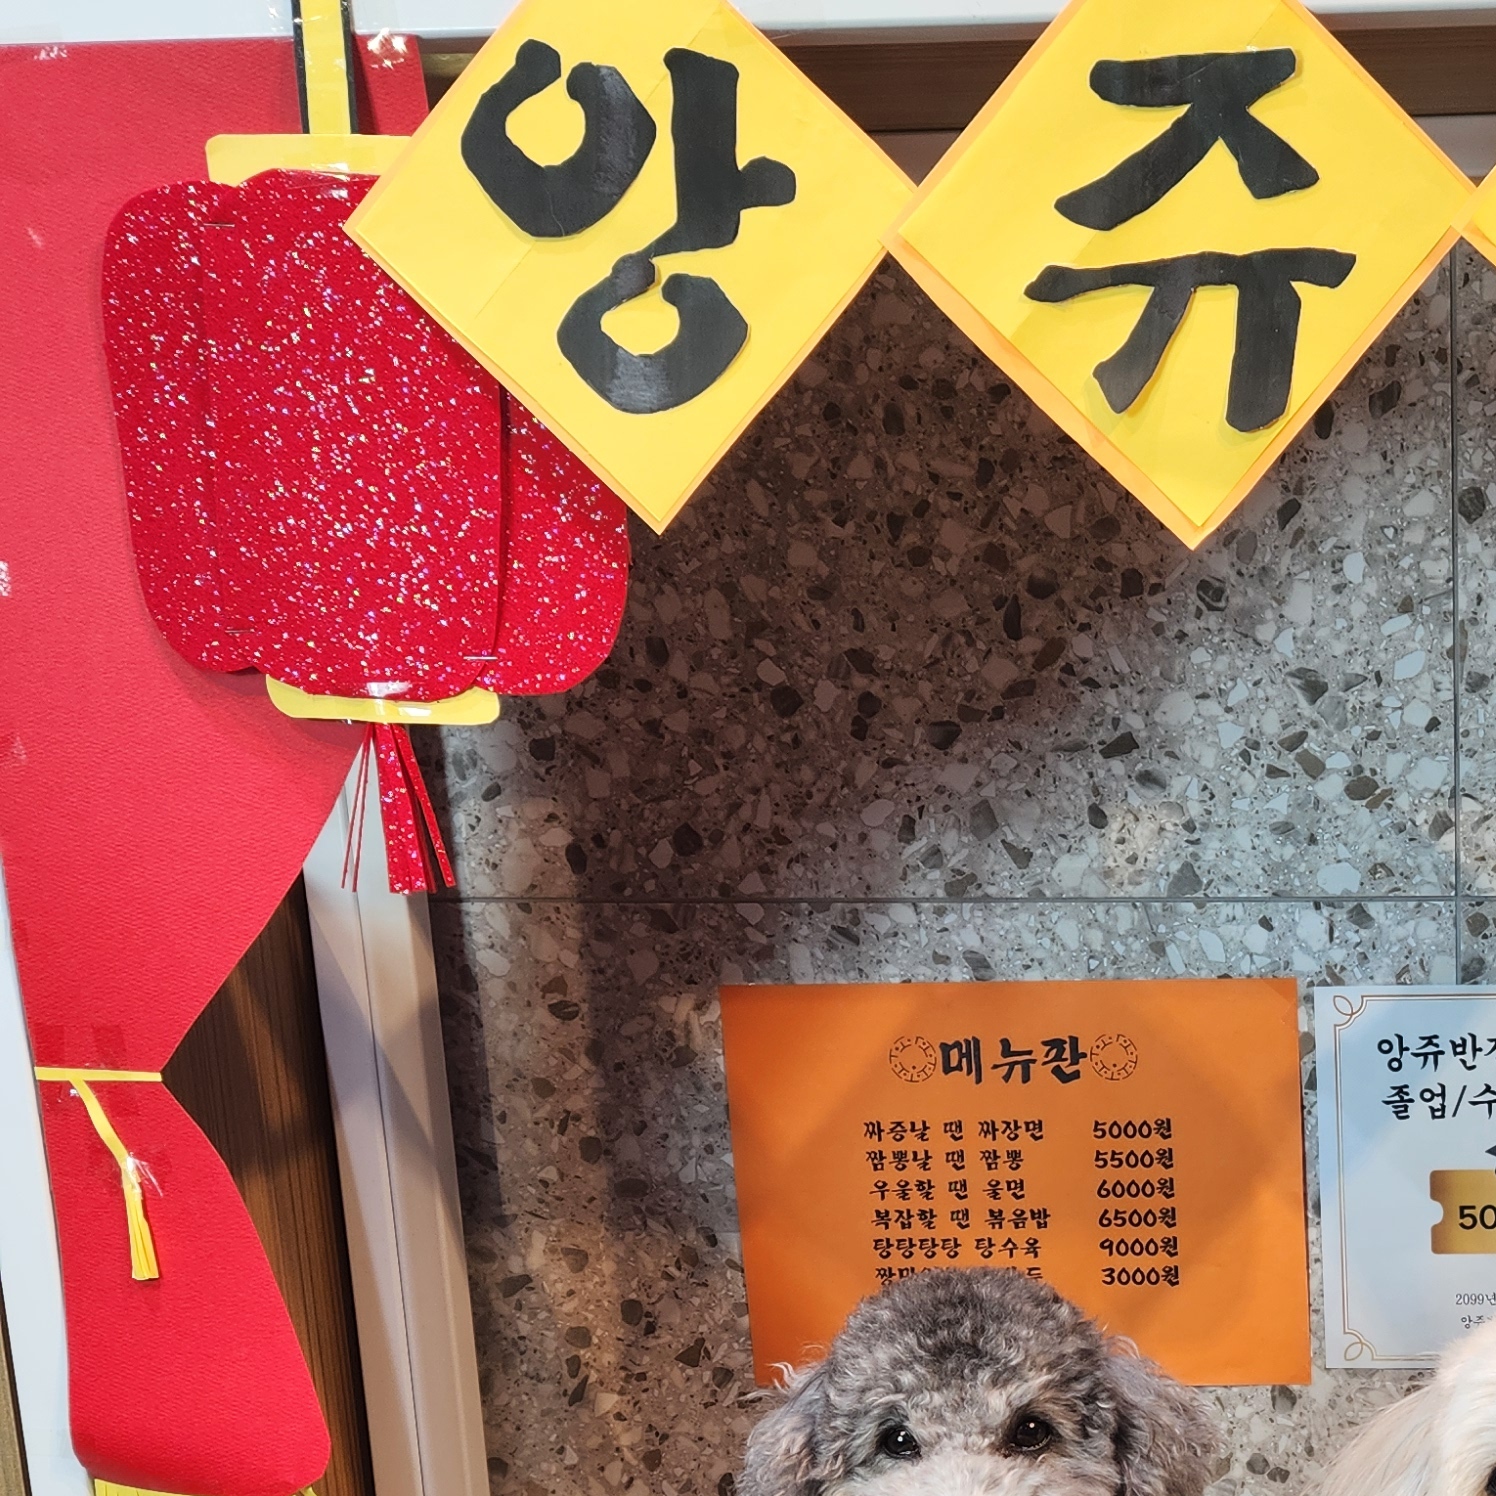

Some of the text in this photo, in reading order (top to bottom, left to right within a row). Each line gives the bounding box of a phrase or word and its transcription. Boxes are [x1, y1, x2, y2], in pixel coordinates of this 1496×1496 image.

[938, 1035, 1088, 1085] 메뉴판
[863, 1117, 1173, 1142] 짜증날 땐 짜장면 5000원
[865, 1147, 1175, 1172] 짬뽕날 땐 짬뽕 5500원
[869, 1177, 1176, 1201] 우울할 땐 울면 6000원
[871, 1206, 1178, 1230] 복잡할 땐 볶음밥 6500원
[872, 1236, 1180, 1259] 탕탕탕탕 탕수육 9000원
[1101, 1264, 1181, 1288] 3000원
[1455, 1292, 1496, 1305] 2099년
